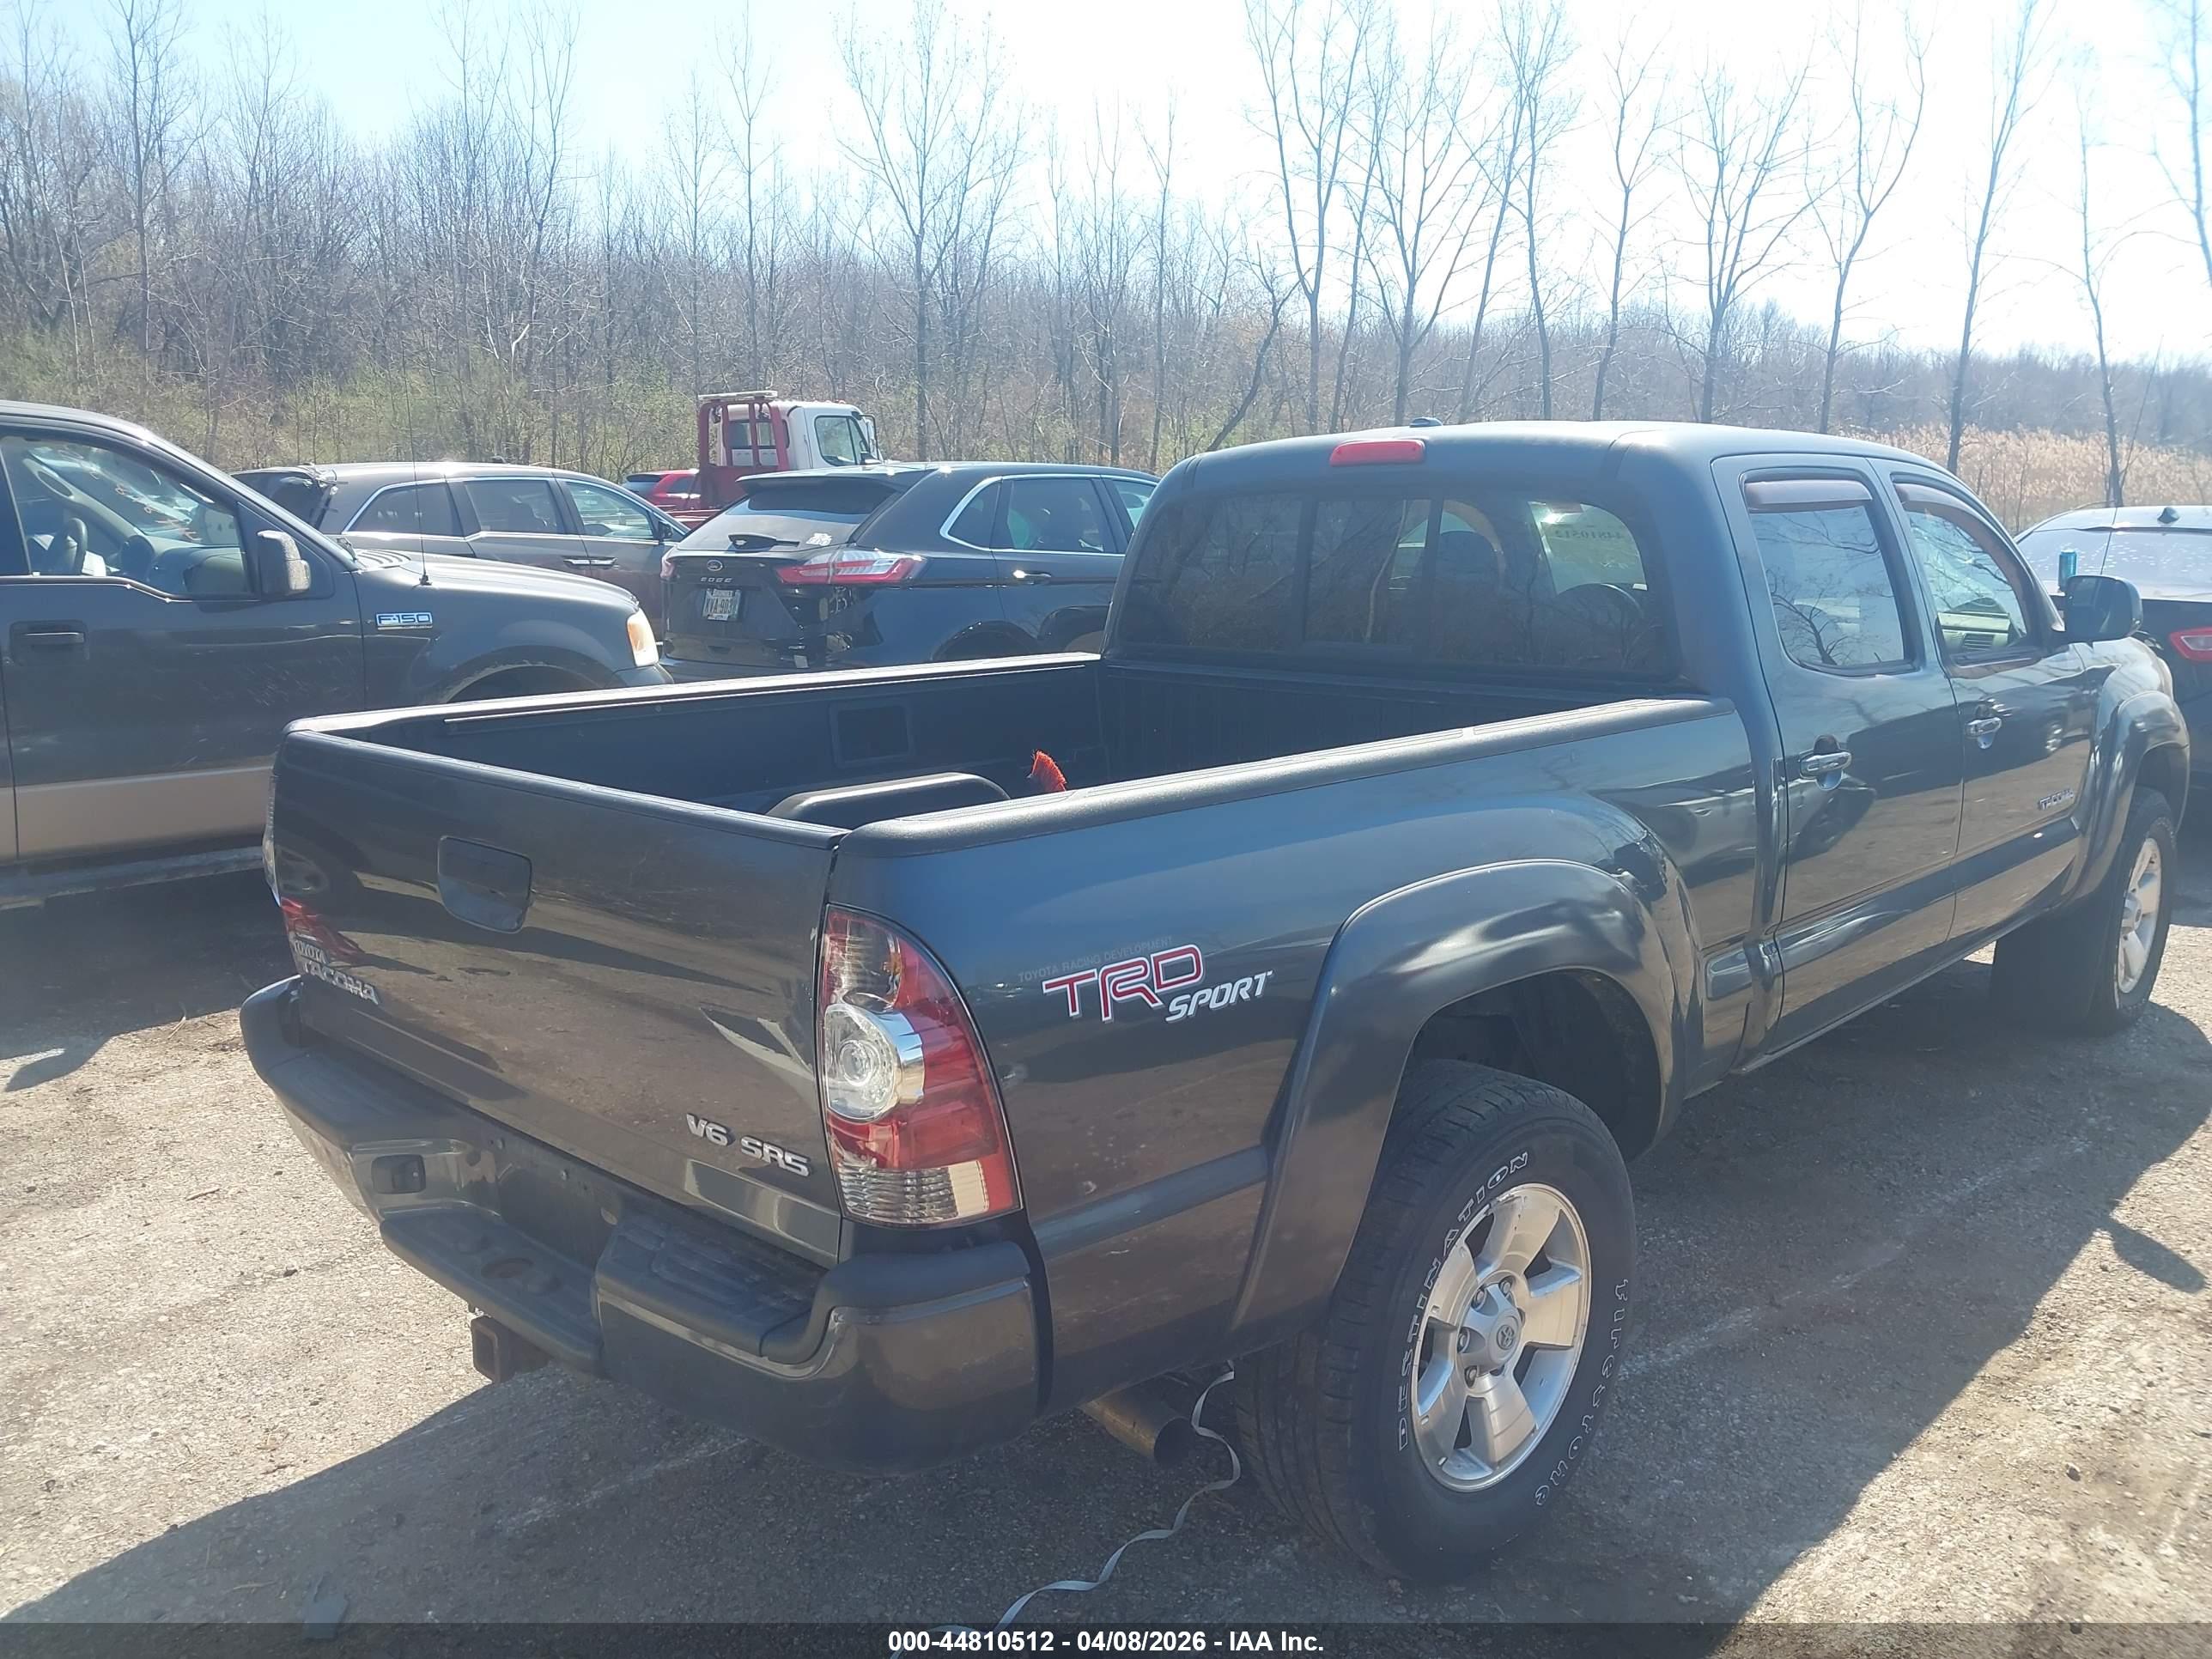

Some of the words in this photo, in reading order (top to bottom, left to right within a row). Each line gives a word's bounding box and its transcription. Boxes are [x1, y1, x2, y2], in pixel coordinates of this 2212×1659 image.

[294, 939, 326, 964] TOYOTA
[1018, 966, 1058, 983] TOYOTA
[1062, 954, 1101, 972] RACING
[1104, 935, 1173, 962] DEVELOPMENT
[1042, 944, 1204, 1022] TRD
[1165, 970, 1273, 1022] SPORT
[686, 1113, 728, 1146] V6
[1398, 1152, 1528, 1451] DESTINATION
